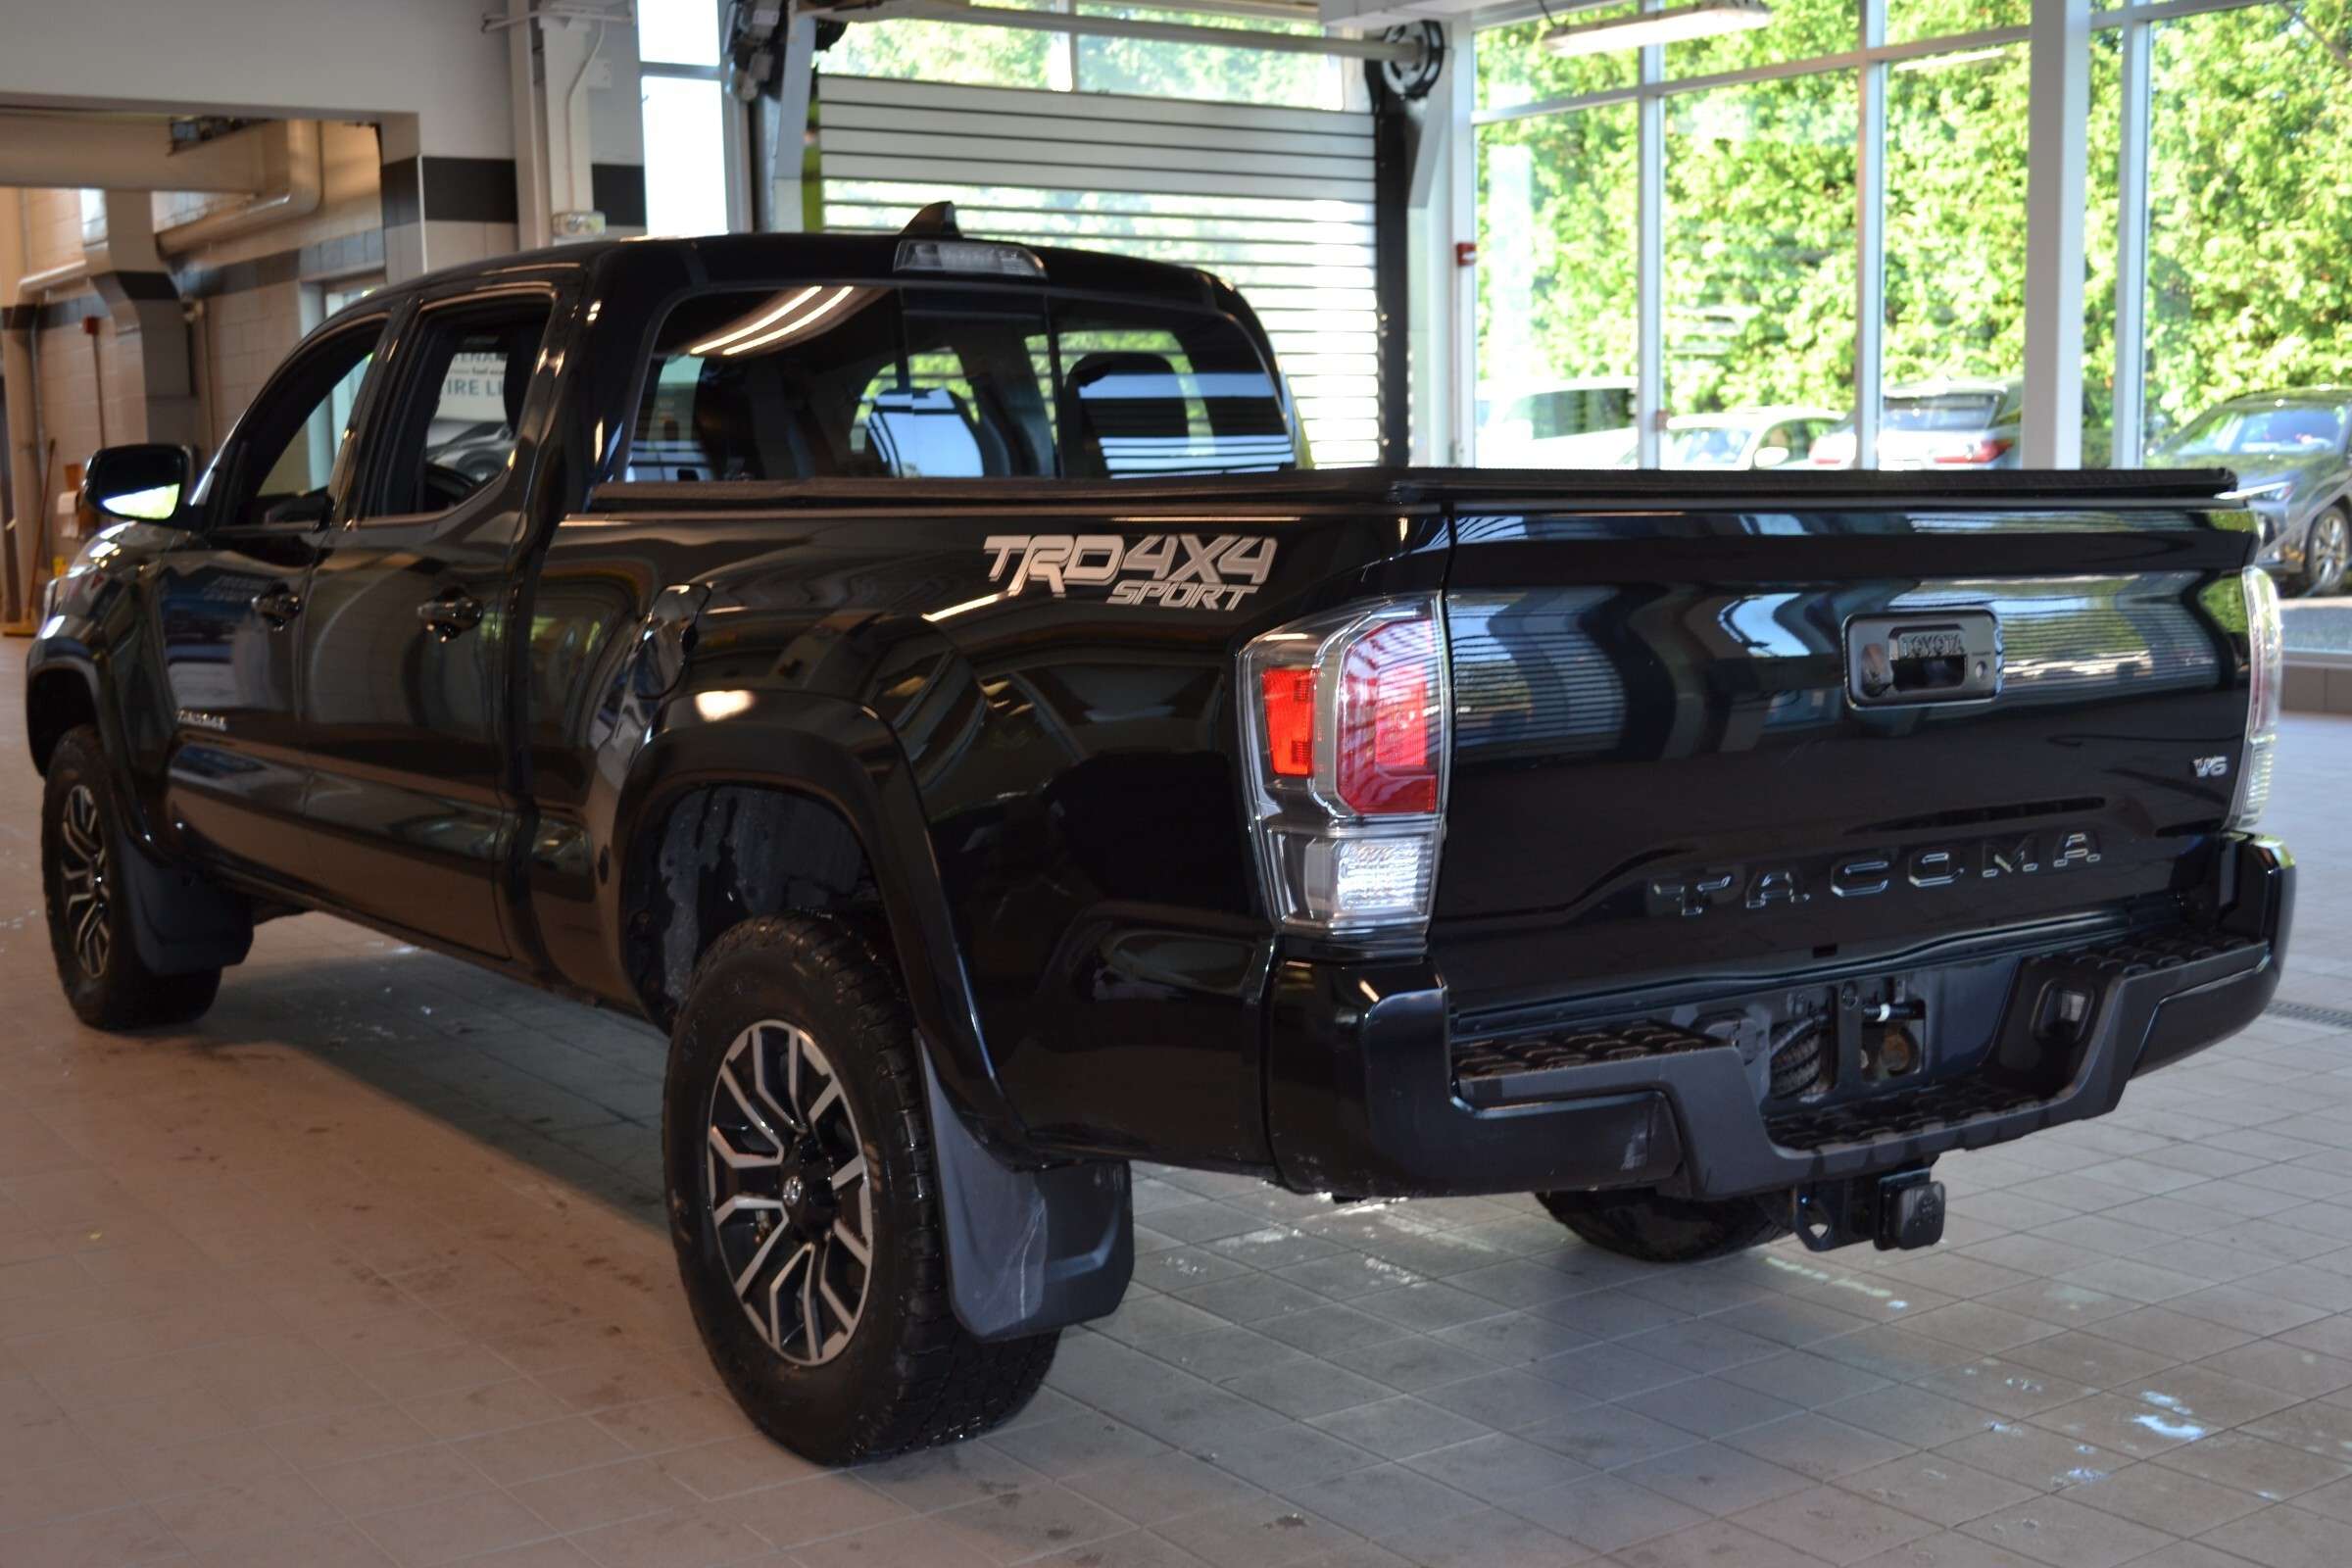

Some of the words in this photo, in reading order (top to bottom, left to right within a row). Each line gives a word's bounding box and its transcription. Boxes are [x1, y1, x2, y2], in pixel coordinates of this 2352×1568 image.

[447, 378, 479, 396] IRE
[983, 535, 1124, 598] TRD
[1120, 534, 1278, 584] 4X4
[1106, 579, 1259, 611] SPORT
[1898, 632, 1965, 659] TOYOTA
[2192, 756, 2228, 777] V6
[1648, 829, 2101, 915] TACOMA
